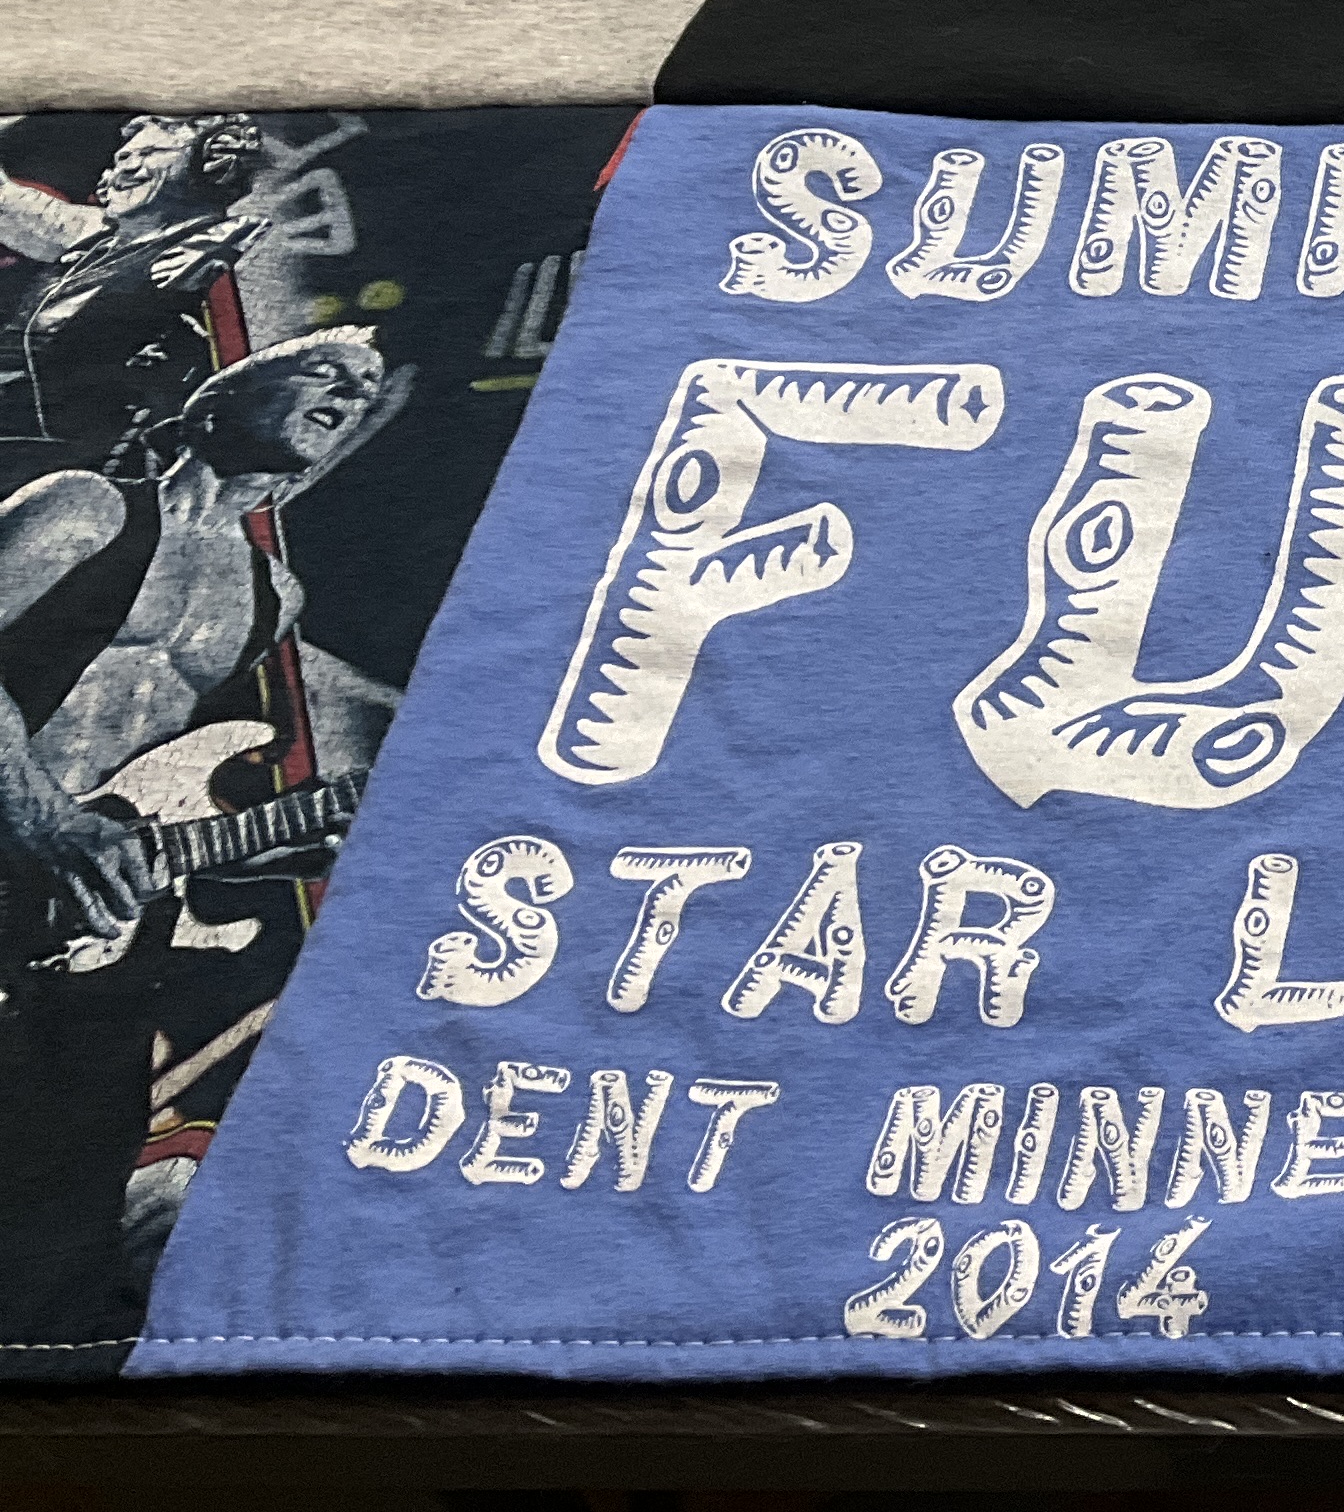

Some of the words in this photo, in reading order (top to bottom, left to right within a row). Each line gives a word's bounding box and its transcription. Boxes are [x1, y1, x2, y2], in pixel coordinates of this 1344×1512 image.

[417, 836, 1057, 1031] STAR
[342, 1055, 781, 1194] DENT
[845, 1215, 1212, 1341] 2014
